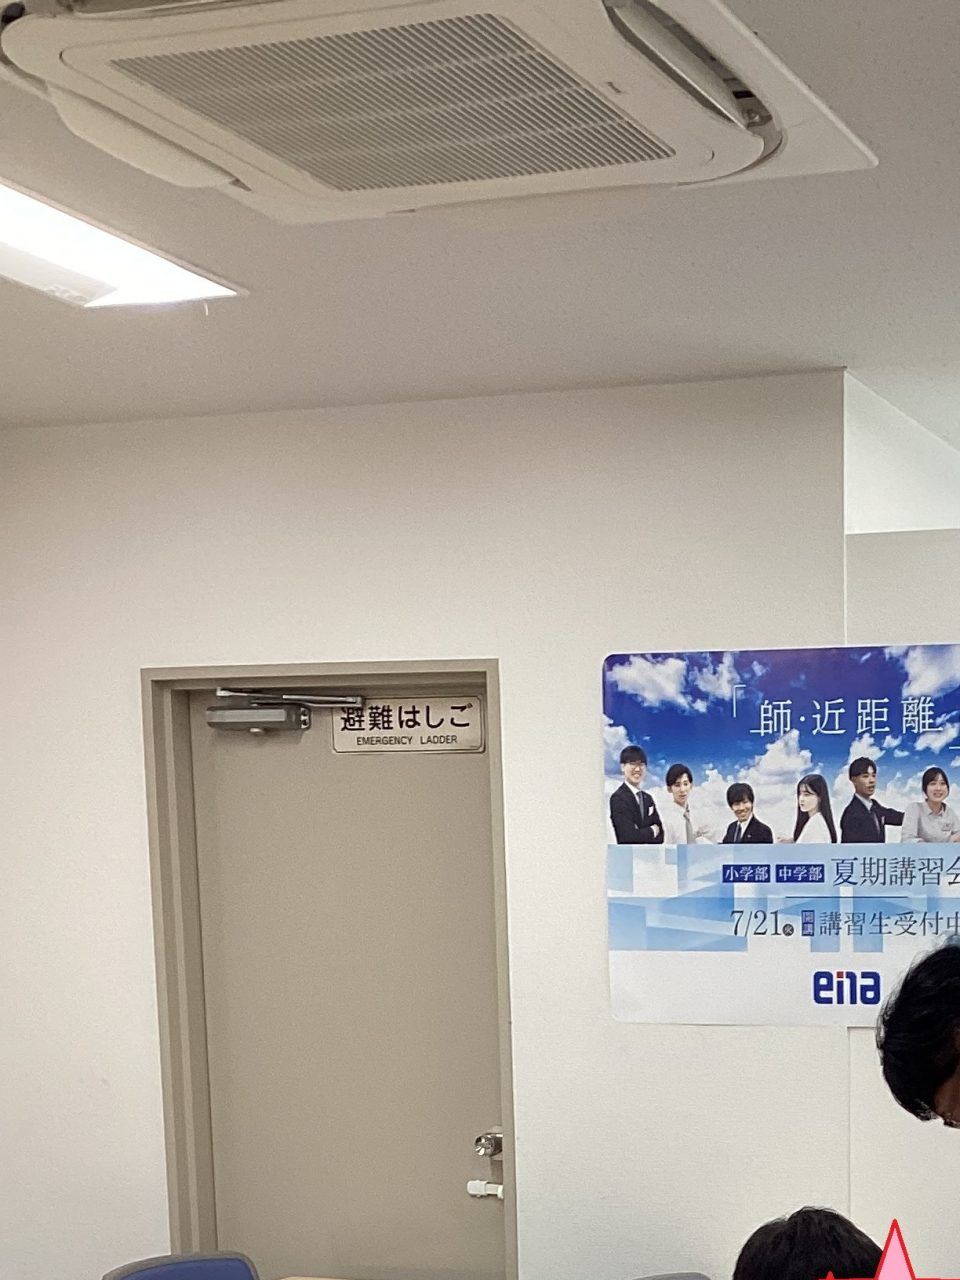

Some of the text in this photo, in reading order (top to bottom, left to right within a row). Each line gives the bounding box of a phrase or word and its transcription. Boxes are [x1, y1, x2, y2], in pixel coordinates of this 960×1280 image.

[341, 702, 473, 731] 避難はしご
[357, 735, 458, 746] EMERGENCY LADDER
[725, 865, 770, 881] 小学部
[778, 865, 824, 882] 中学部
